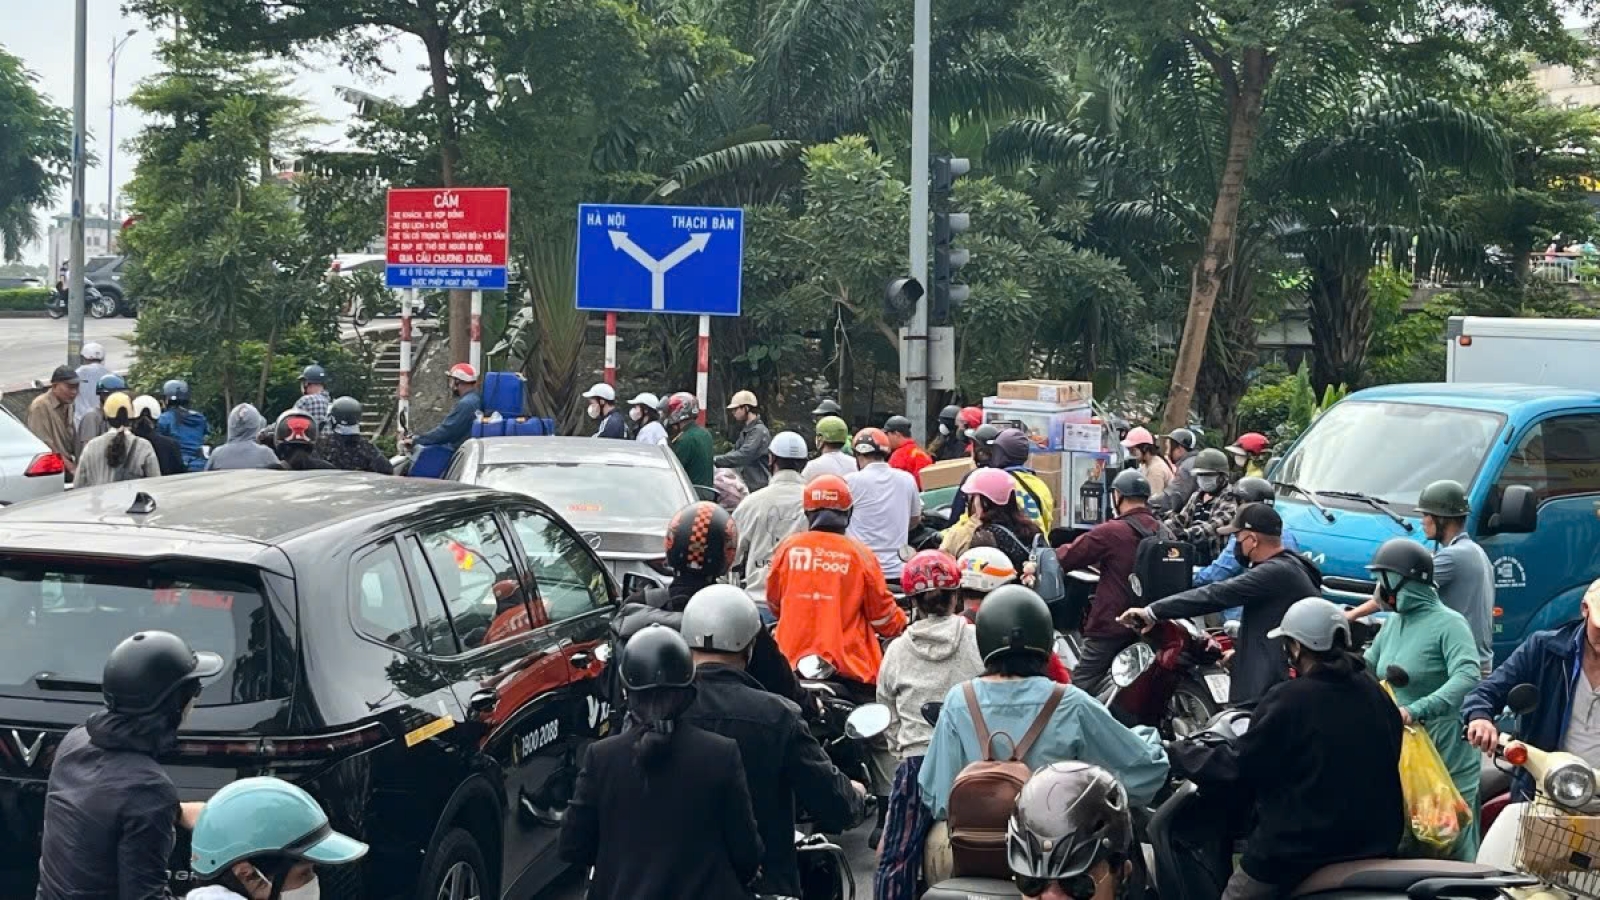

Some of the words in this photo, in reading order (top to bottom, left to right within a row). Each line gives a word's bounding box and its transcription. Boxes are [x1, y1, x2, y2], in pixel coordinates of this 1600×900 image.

[434, 189, 459, 208] CẤM
[587, 210, 601, 225] HÀ
[607, 212, 626, 229] NỘI
[671, 215, 708, 232] THẠCH
[712, 213, 735, 230] BÀN
[813, 561, 849, 574] Food
[522, 729, 540, 758] 1900
